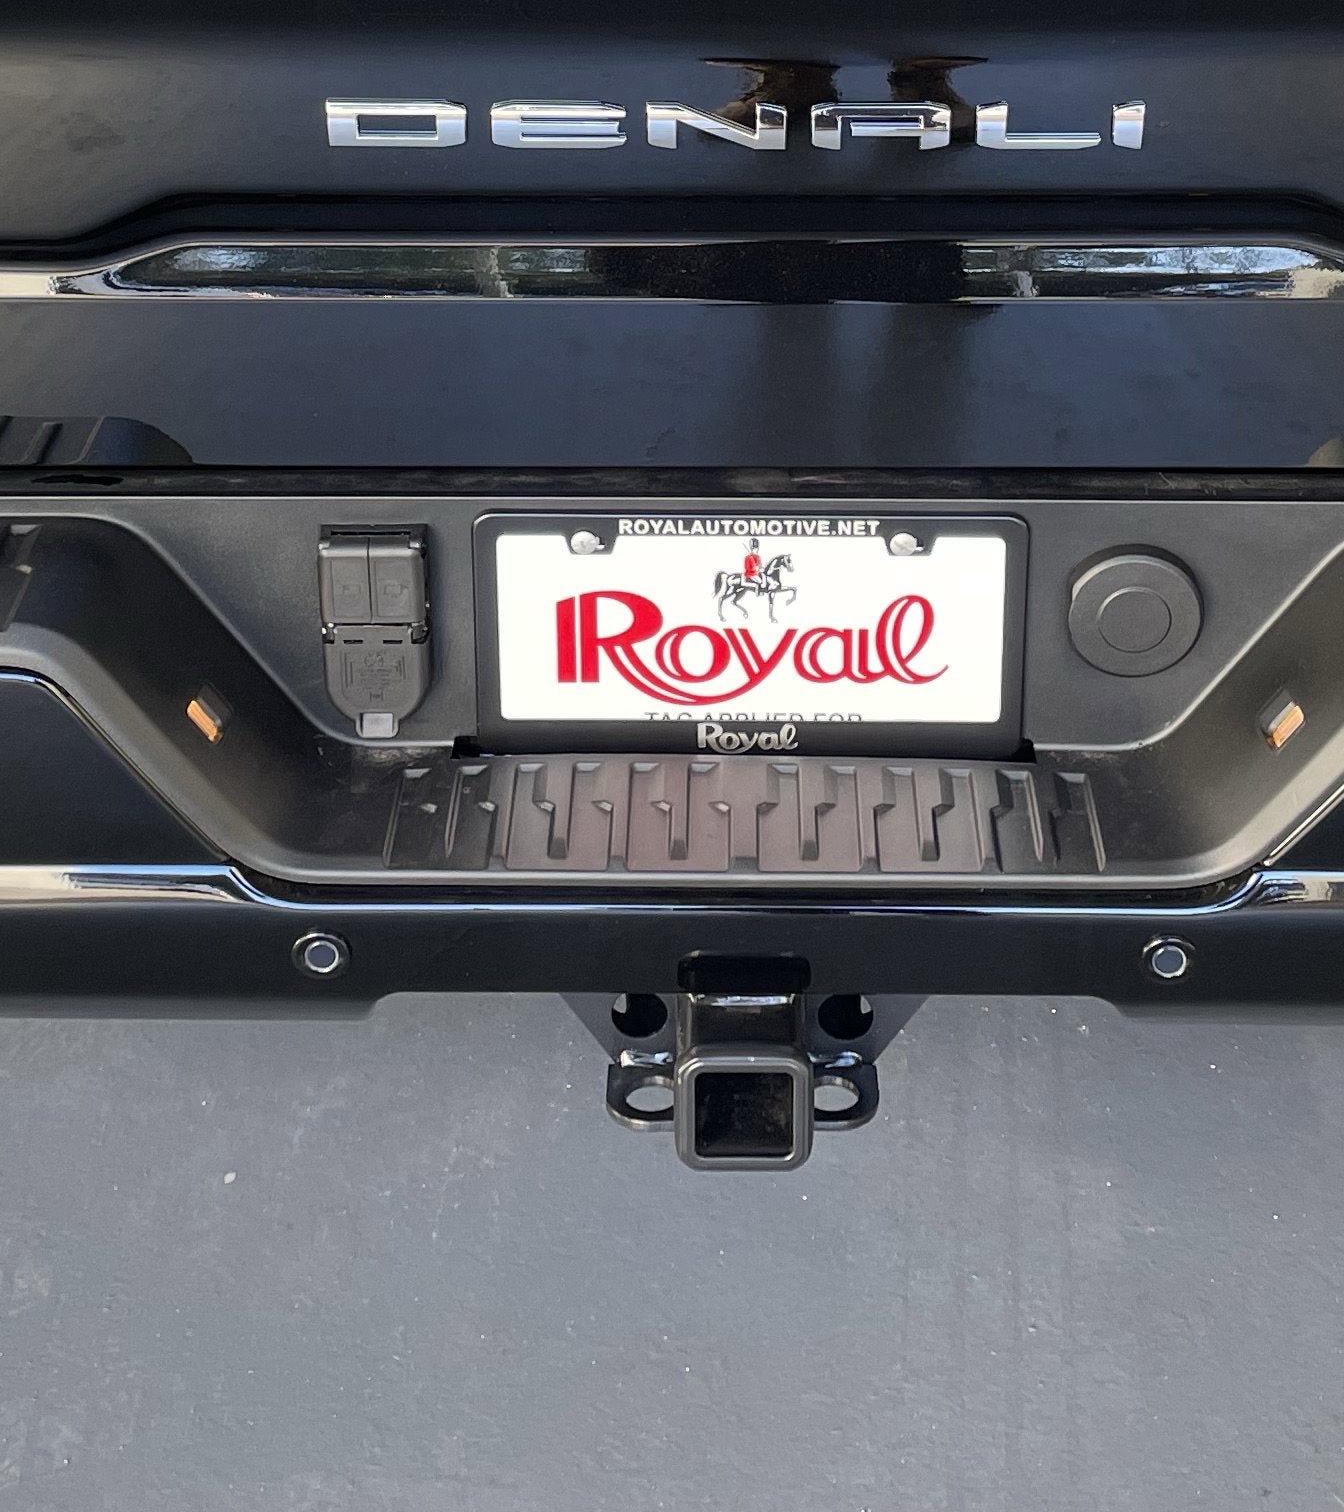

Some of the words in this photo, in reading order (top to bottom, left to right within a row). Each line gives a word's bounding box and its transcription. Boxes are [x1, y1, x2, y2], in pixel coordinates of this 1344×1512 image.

[325, 97, 1146, 151] DENALI
[618, 519, 880, 536] ROYALAUTOMOTIVE.NET
[556, 590, 949, 706] Royal
[697, 722, 798, 754] Royal
